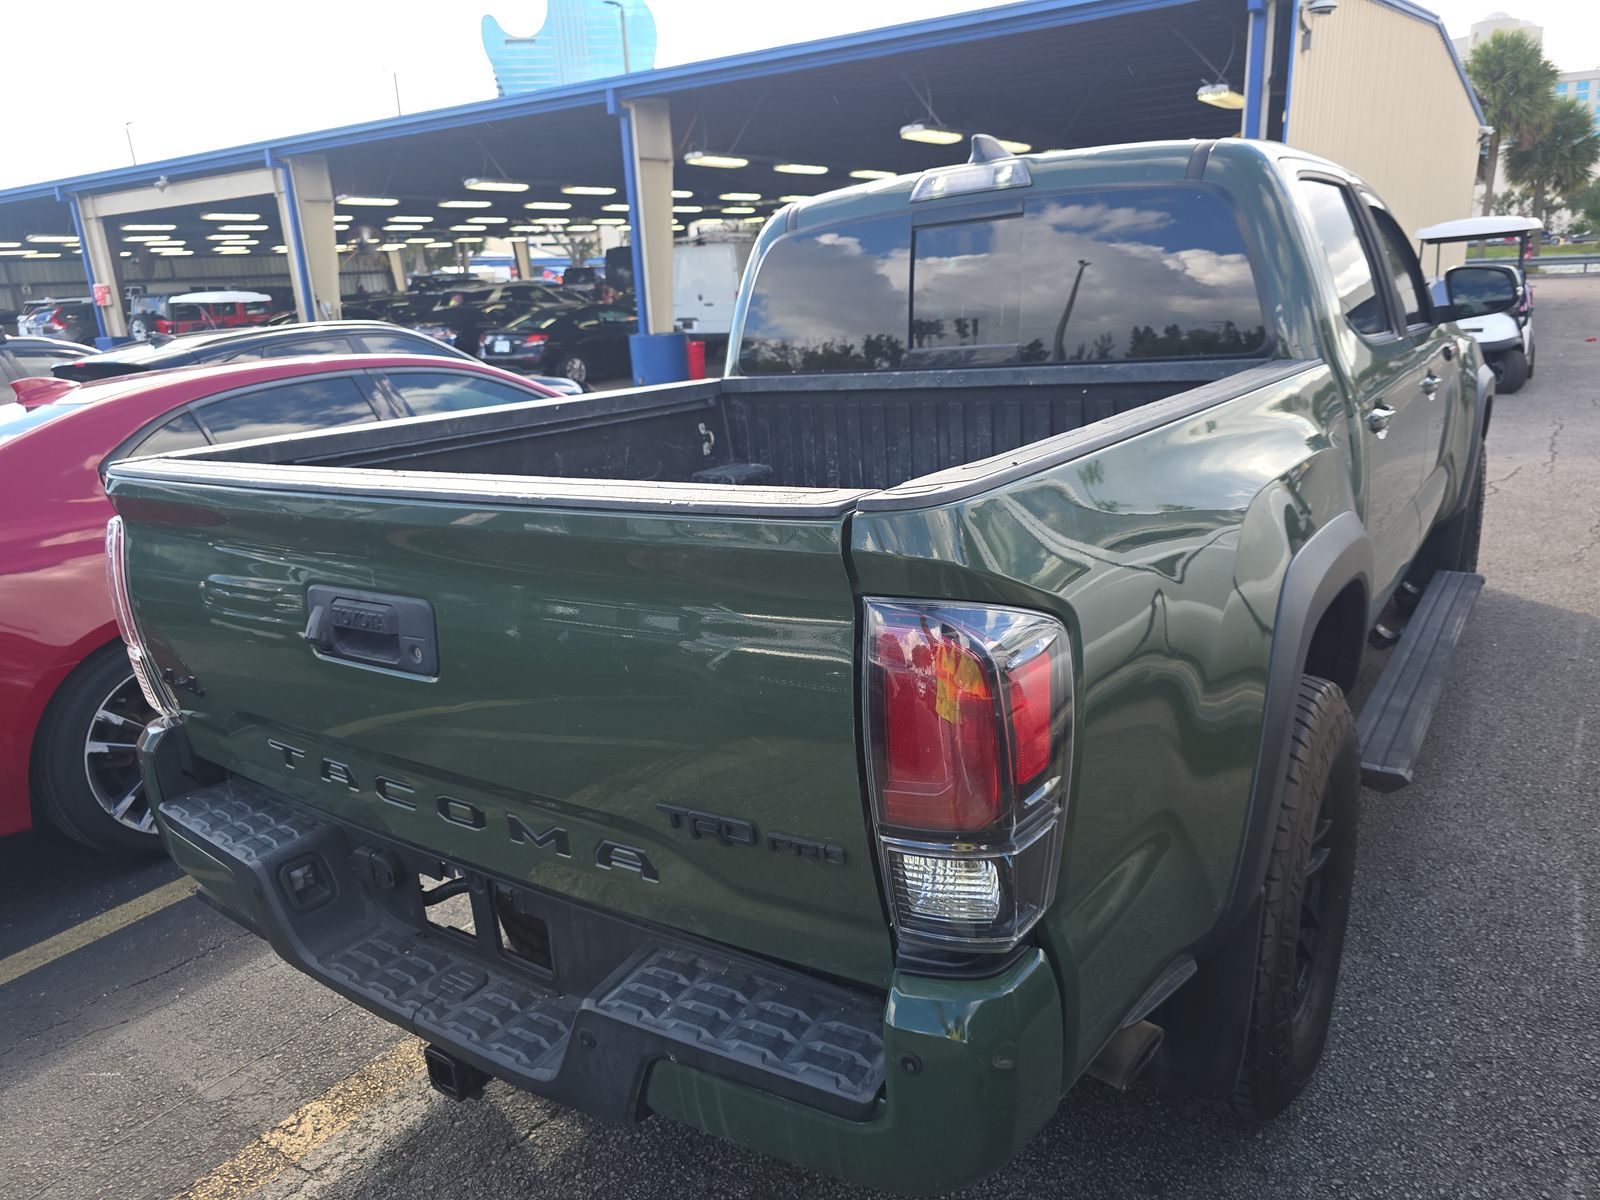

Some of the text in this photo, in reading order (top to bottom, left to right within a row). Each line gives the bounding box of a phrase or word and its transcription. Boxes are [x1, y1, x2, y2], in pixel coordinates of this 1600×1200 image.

[331, 606, 385, 634] TOYOTA
[267, 738, 660, 883] TACOMA
[656, 803, 847, 865] TRD PRO
